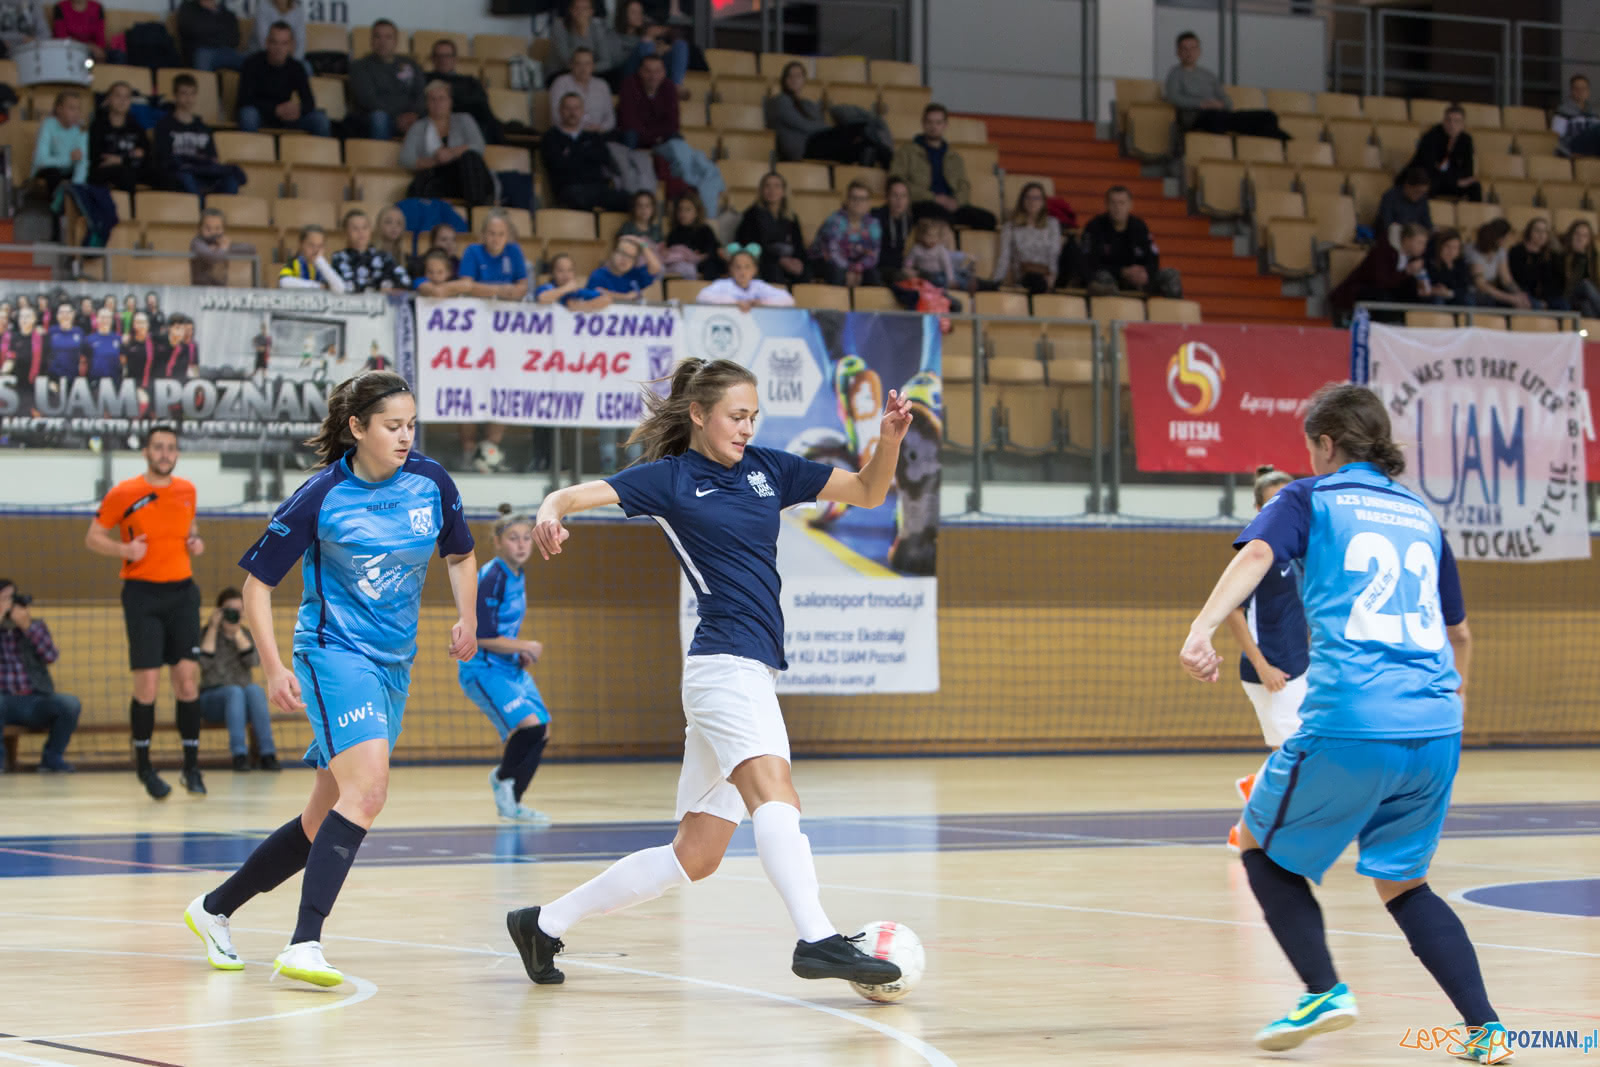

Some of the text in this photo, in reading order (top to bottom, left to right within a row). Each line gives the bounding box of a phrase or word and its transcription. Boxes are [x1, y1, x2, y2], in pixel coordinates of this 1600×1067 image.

[427, 308, 674, 337] AZS UAM POZNAŃ
[521, 349, 632, 379] ZAJĄC
[1453, 357, 1475, 378] TO
[34, 377, 140, 416] UAM
[436, 388, 472, 417] LPFA
[491, 388, 584, 419] DZIEWCZYNY
[596, 391, 643, 420] LECHA
[267, 421, 322, 435] KOBIE
[1169, 421, 1221, 441] FUTSAL
[1416, 398, 1526, 506] UAM
[366, 501, 400, 511] saller
[1461, 530, 1489, 557] TO
[794, 592, 924, 611] salonsportmoda.pl
[1344, 531, 1446, 651] 23
[817, 650, 838, 663] AZS
[841, 650, 866, 663] UAM
